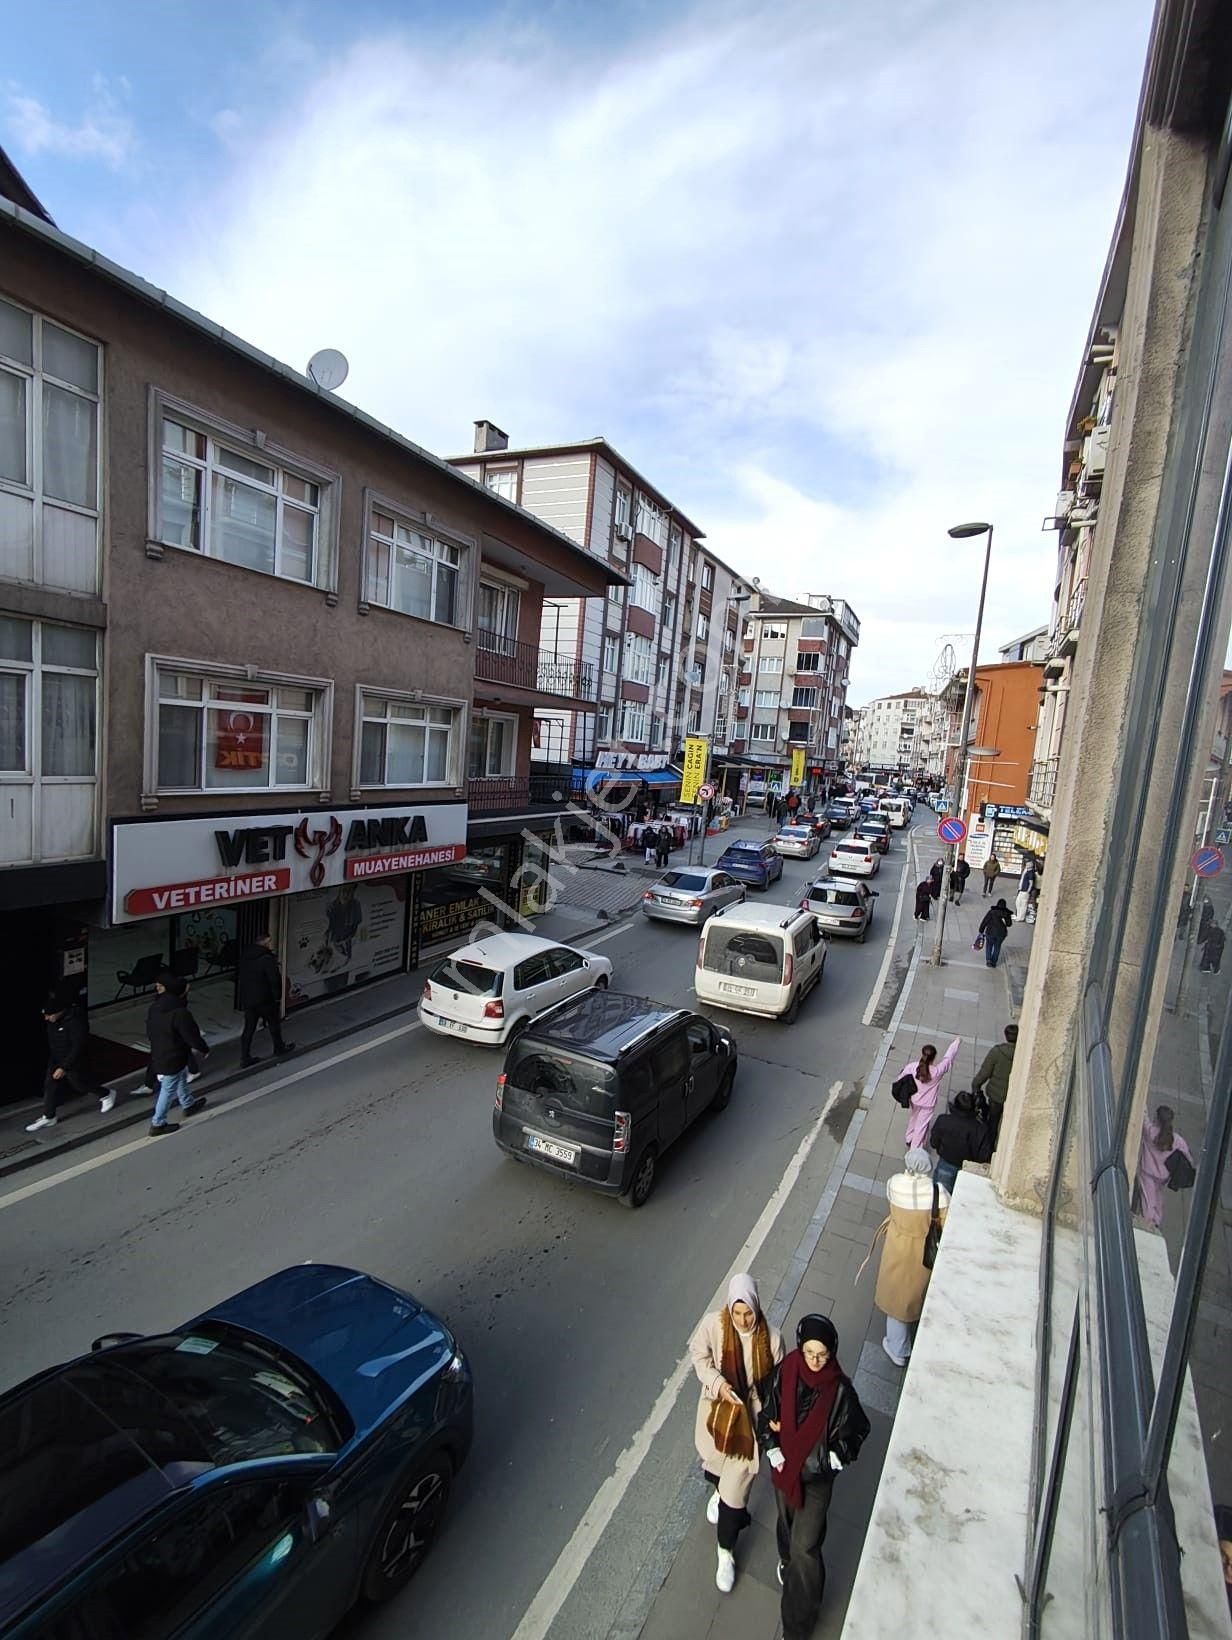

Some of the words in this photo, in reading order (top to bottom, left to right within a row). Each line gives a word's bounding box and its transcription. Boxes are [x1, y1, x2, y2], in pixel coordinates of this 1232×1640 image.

[215, 825, 293, 867] VET
[345, 815, 428, 851] ANKA
[152, 876, 277, 909] VETERİNER
[353, 847, 455, 876] MUAYENEHANESİ
[555, 1147, 573, 1160] 3559
